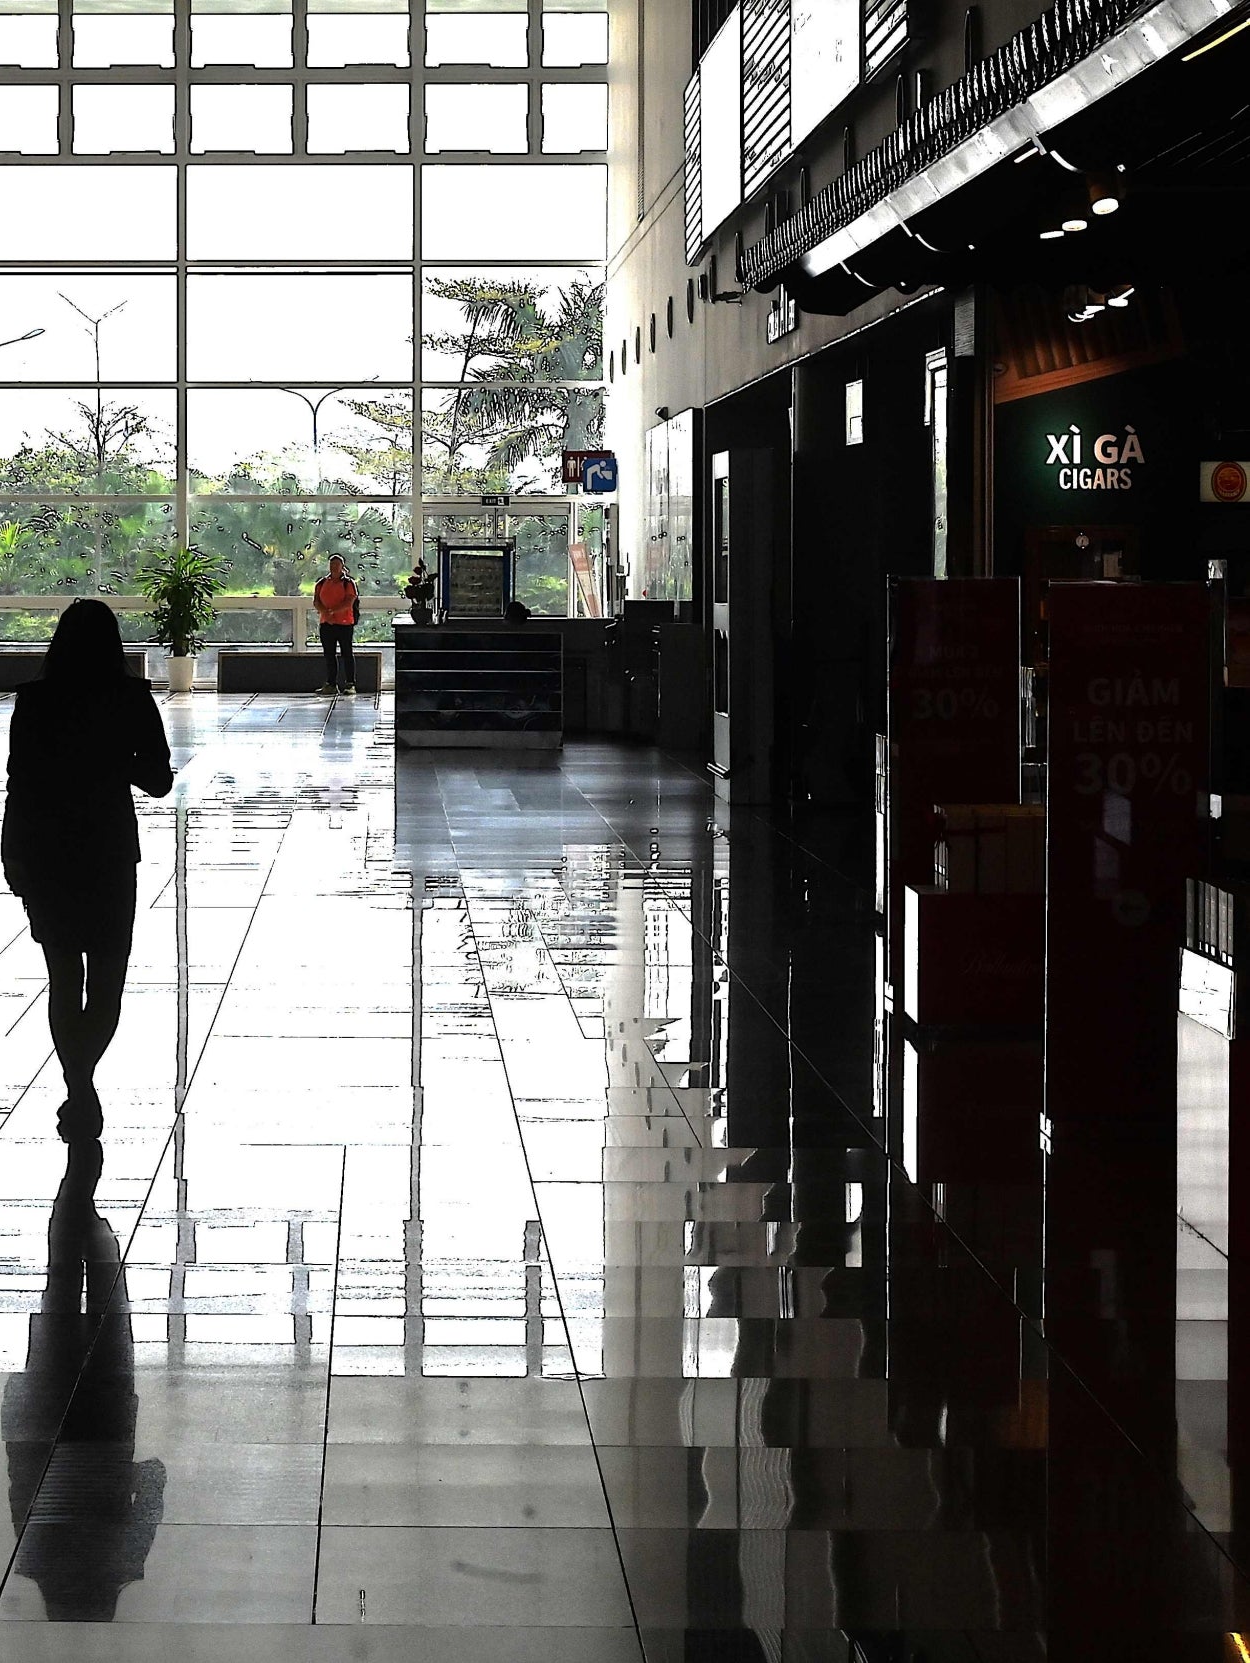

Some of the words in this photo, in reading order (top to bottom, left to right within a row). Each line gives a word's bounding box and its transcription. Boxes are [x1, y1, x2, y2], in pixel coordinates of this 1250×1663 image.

[1045, 424, 1081, 464] XÌ
[1093, 424, 1145, 464] GÀ
[1058, 468, 1133, 490] CIGARS
[1072, 751, 1193, 797] 30%
